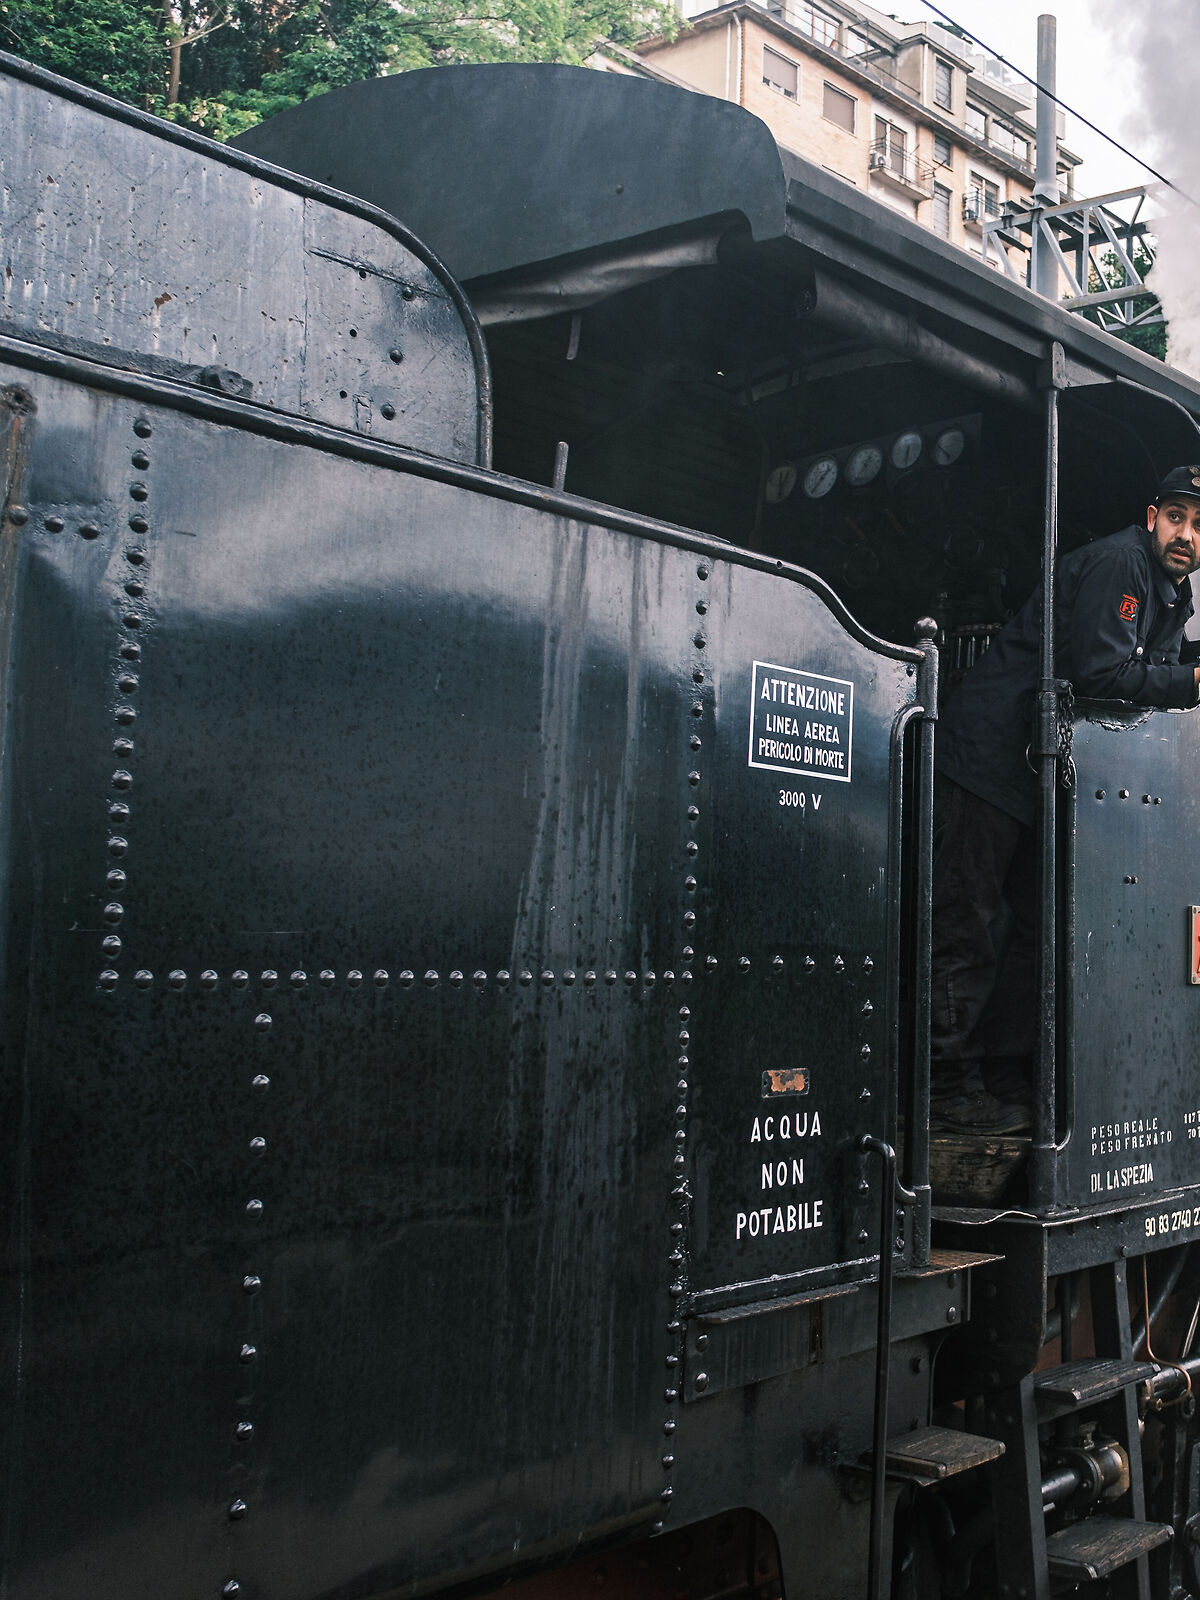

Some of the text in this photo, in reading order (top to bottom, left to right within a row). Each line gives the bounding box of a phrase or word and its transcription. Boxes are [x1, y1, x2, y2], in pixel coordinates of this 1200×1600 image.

[761, 677, 845, 715] ATTENZIONE
[766, 713, 840, 744] LINEA AEREA
[758, 737, 845, 769] PERICOLO DI MORTE
[779, 789, 822, 810] 3000 V
[750, 1111, 822, 1143] ACQUA
[1091, 1122, 1120, 1140] PESO
[1123, 1117, 1158, 1135] REALE
[1091, 1138, 1121, 1156] PESO
[761, 1158, 804, 1190] NON
[1121, 1163, 1154, 1187] SPEZIA
[736, 1200, 823, 1240] POTABILE
[1145, 1217, 1156, 1237] 90
[1158, 1214, 1169, 1234] 83
[1171, 1209, 1192, 1231] 2740
